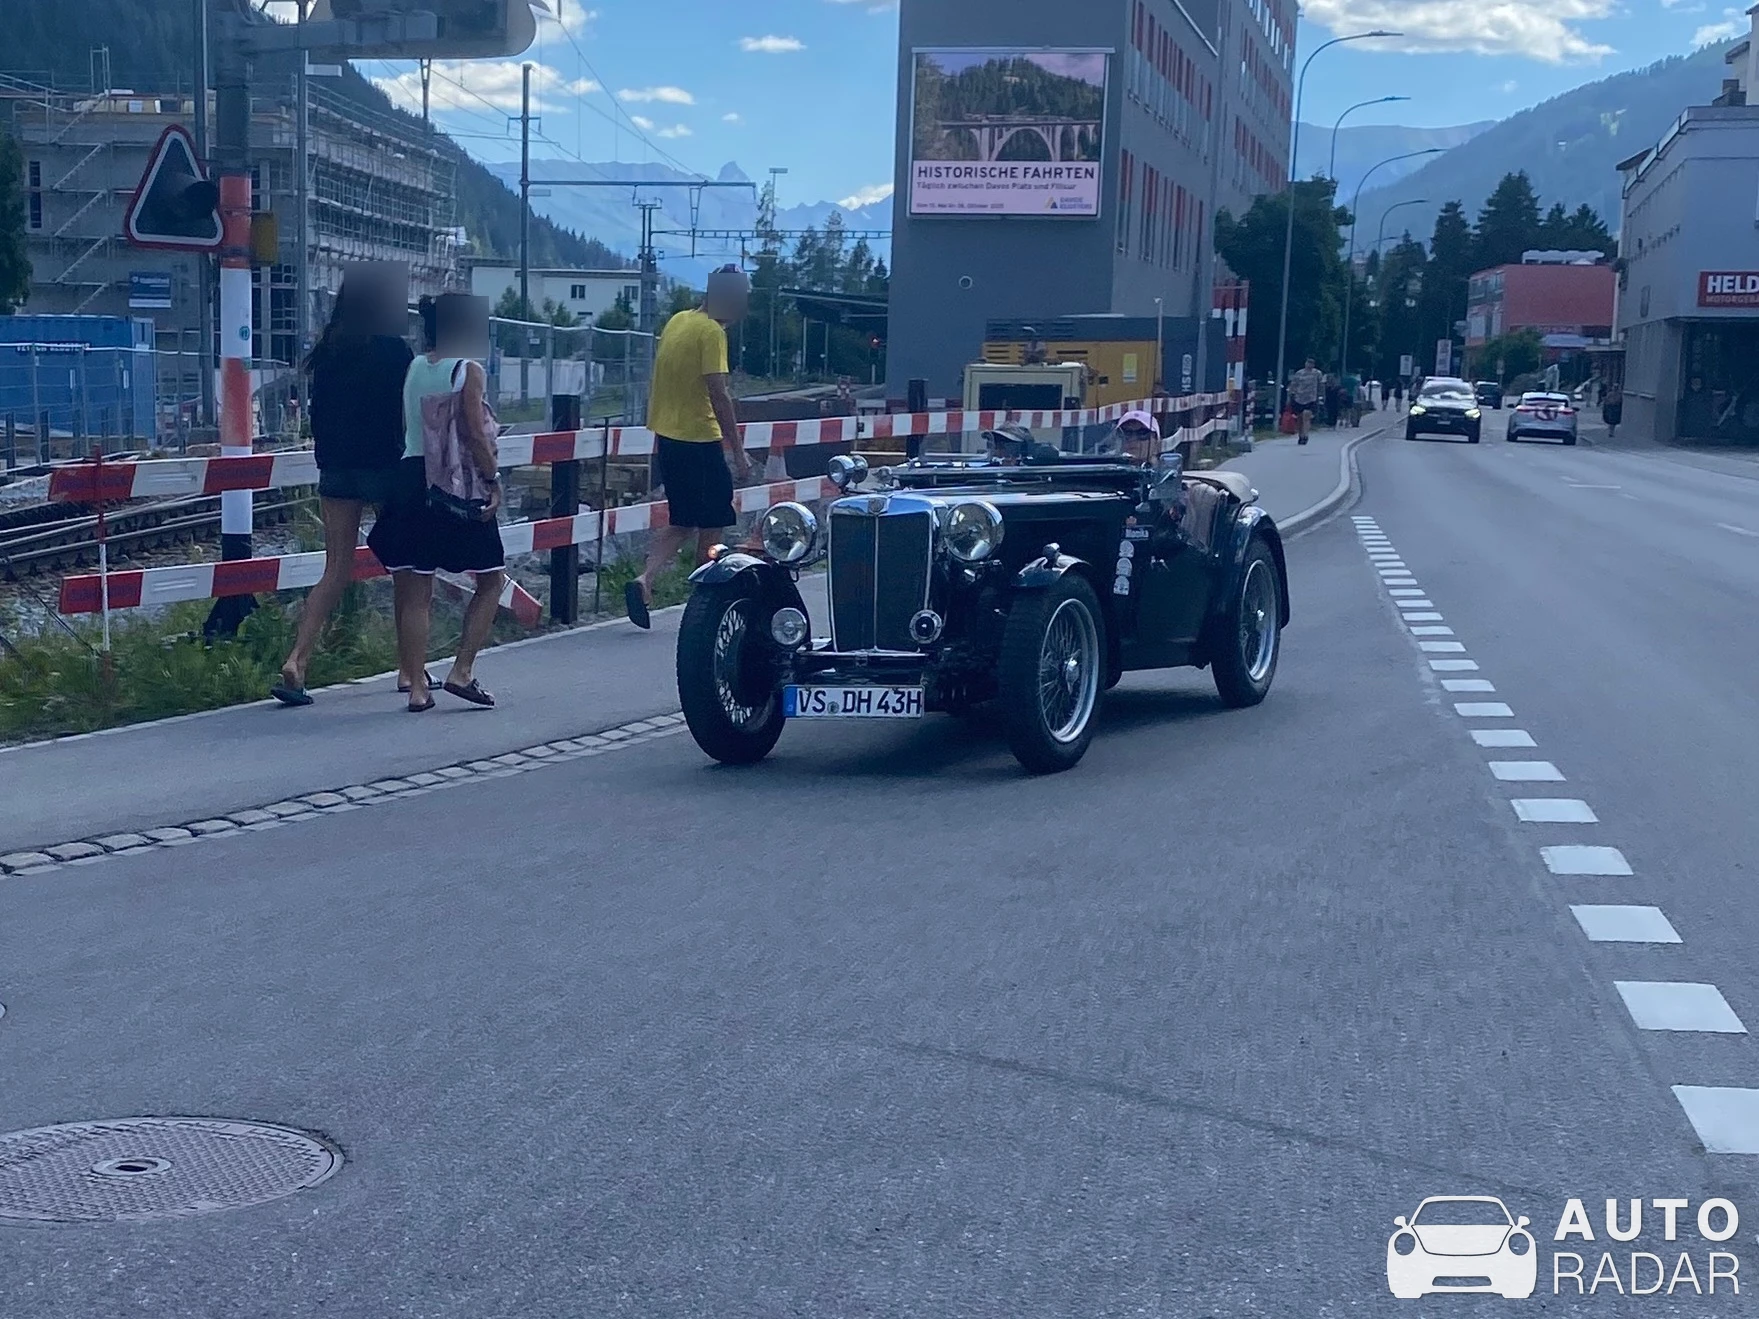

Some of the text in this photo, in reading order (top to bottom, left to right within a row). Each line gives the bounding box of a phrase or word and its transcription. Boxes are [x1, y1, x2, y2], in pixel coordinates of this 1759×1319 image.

[918, 166, 1095, 180] HISTORISCHE FAHRTEN
[798, 689, 921, 714] VS DH 43H
